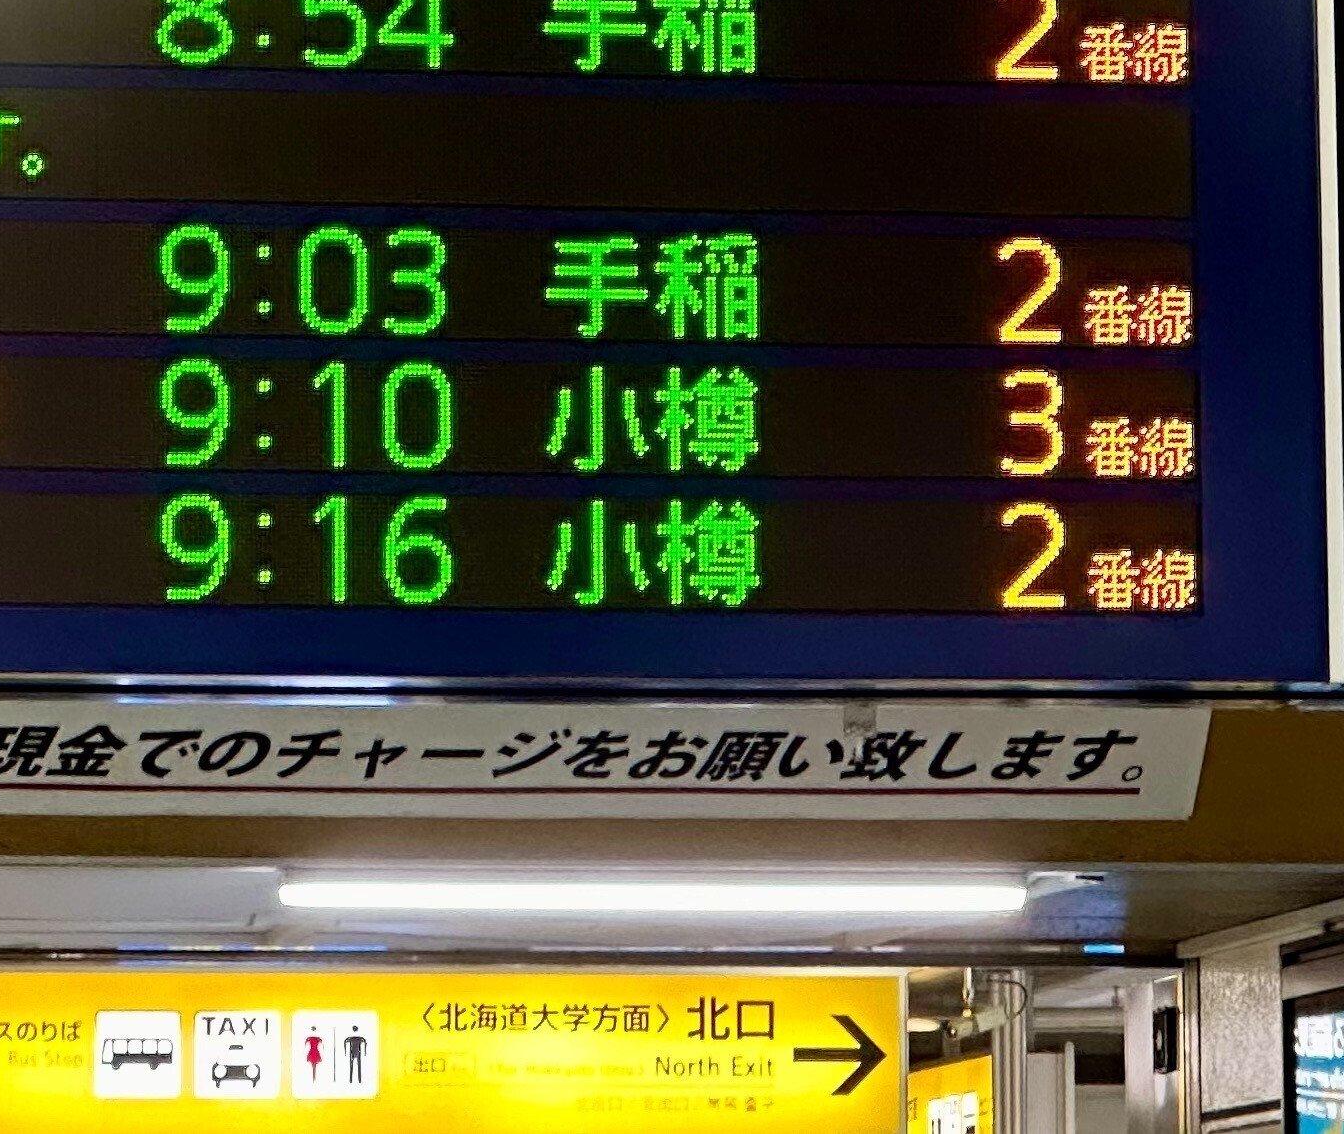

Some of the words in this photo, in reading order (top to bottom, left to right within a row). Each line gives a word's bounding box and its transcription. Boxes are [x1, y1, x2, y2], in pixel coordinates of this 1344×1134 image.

[162, 225, 445, 334] 9:03
[546, 234, 758, 338] 手稲
[162, 359, 451, 468] 9:10
[546, 366, 759, 471] 小樽
[162, 494, 451, 604] 9:16
[547, 499, 760, 605] 小樽
[202, 1017, 269, 1036] TAXI
[686, 996, 775, 1040] 北口
[655, 1056, 721, 1077] North
[732, 1056, 776, 1078] Exit
